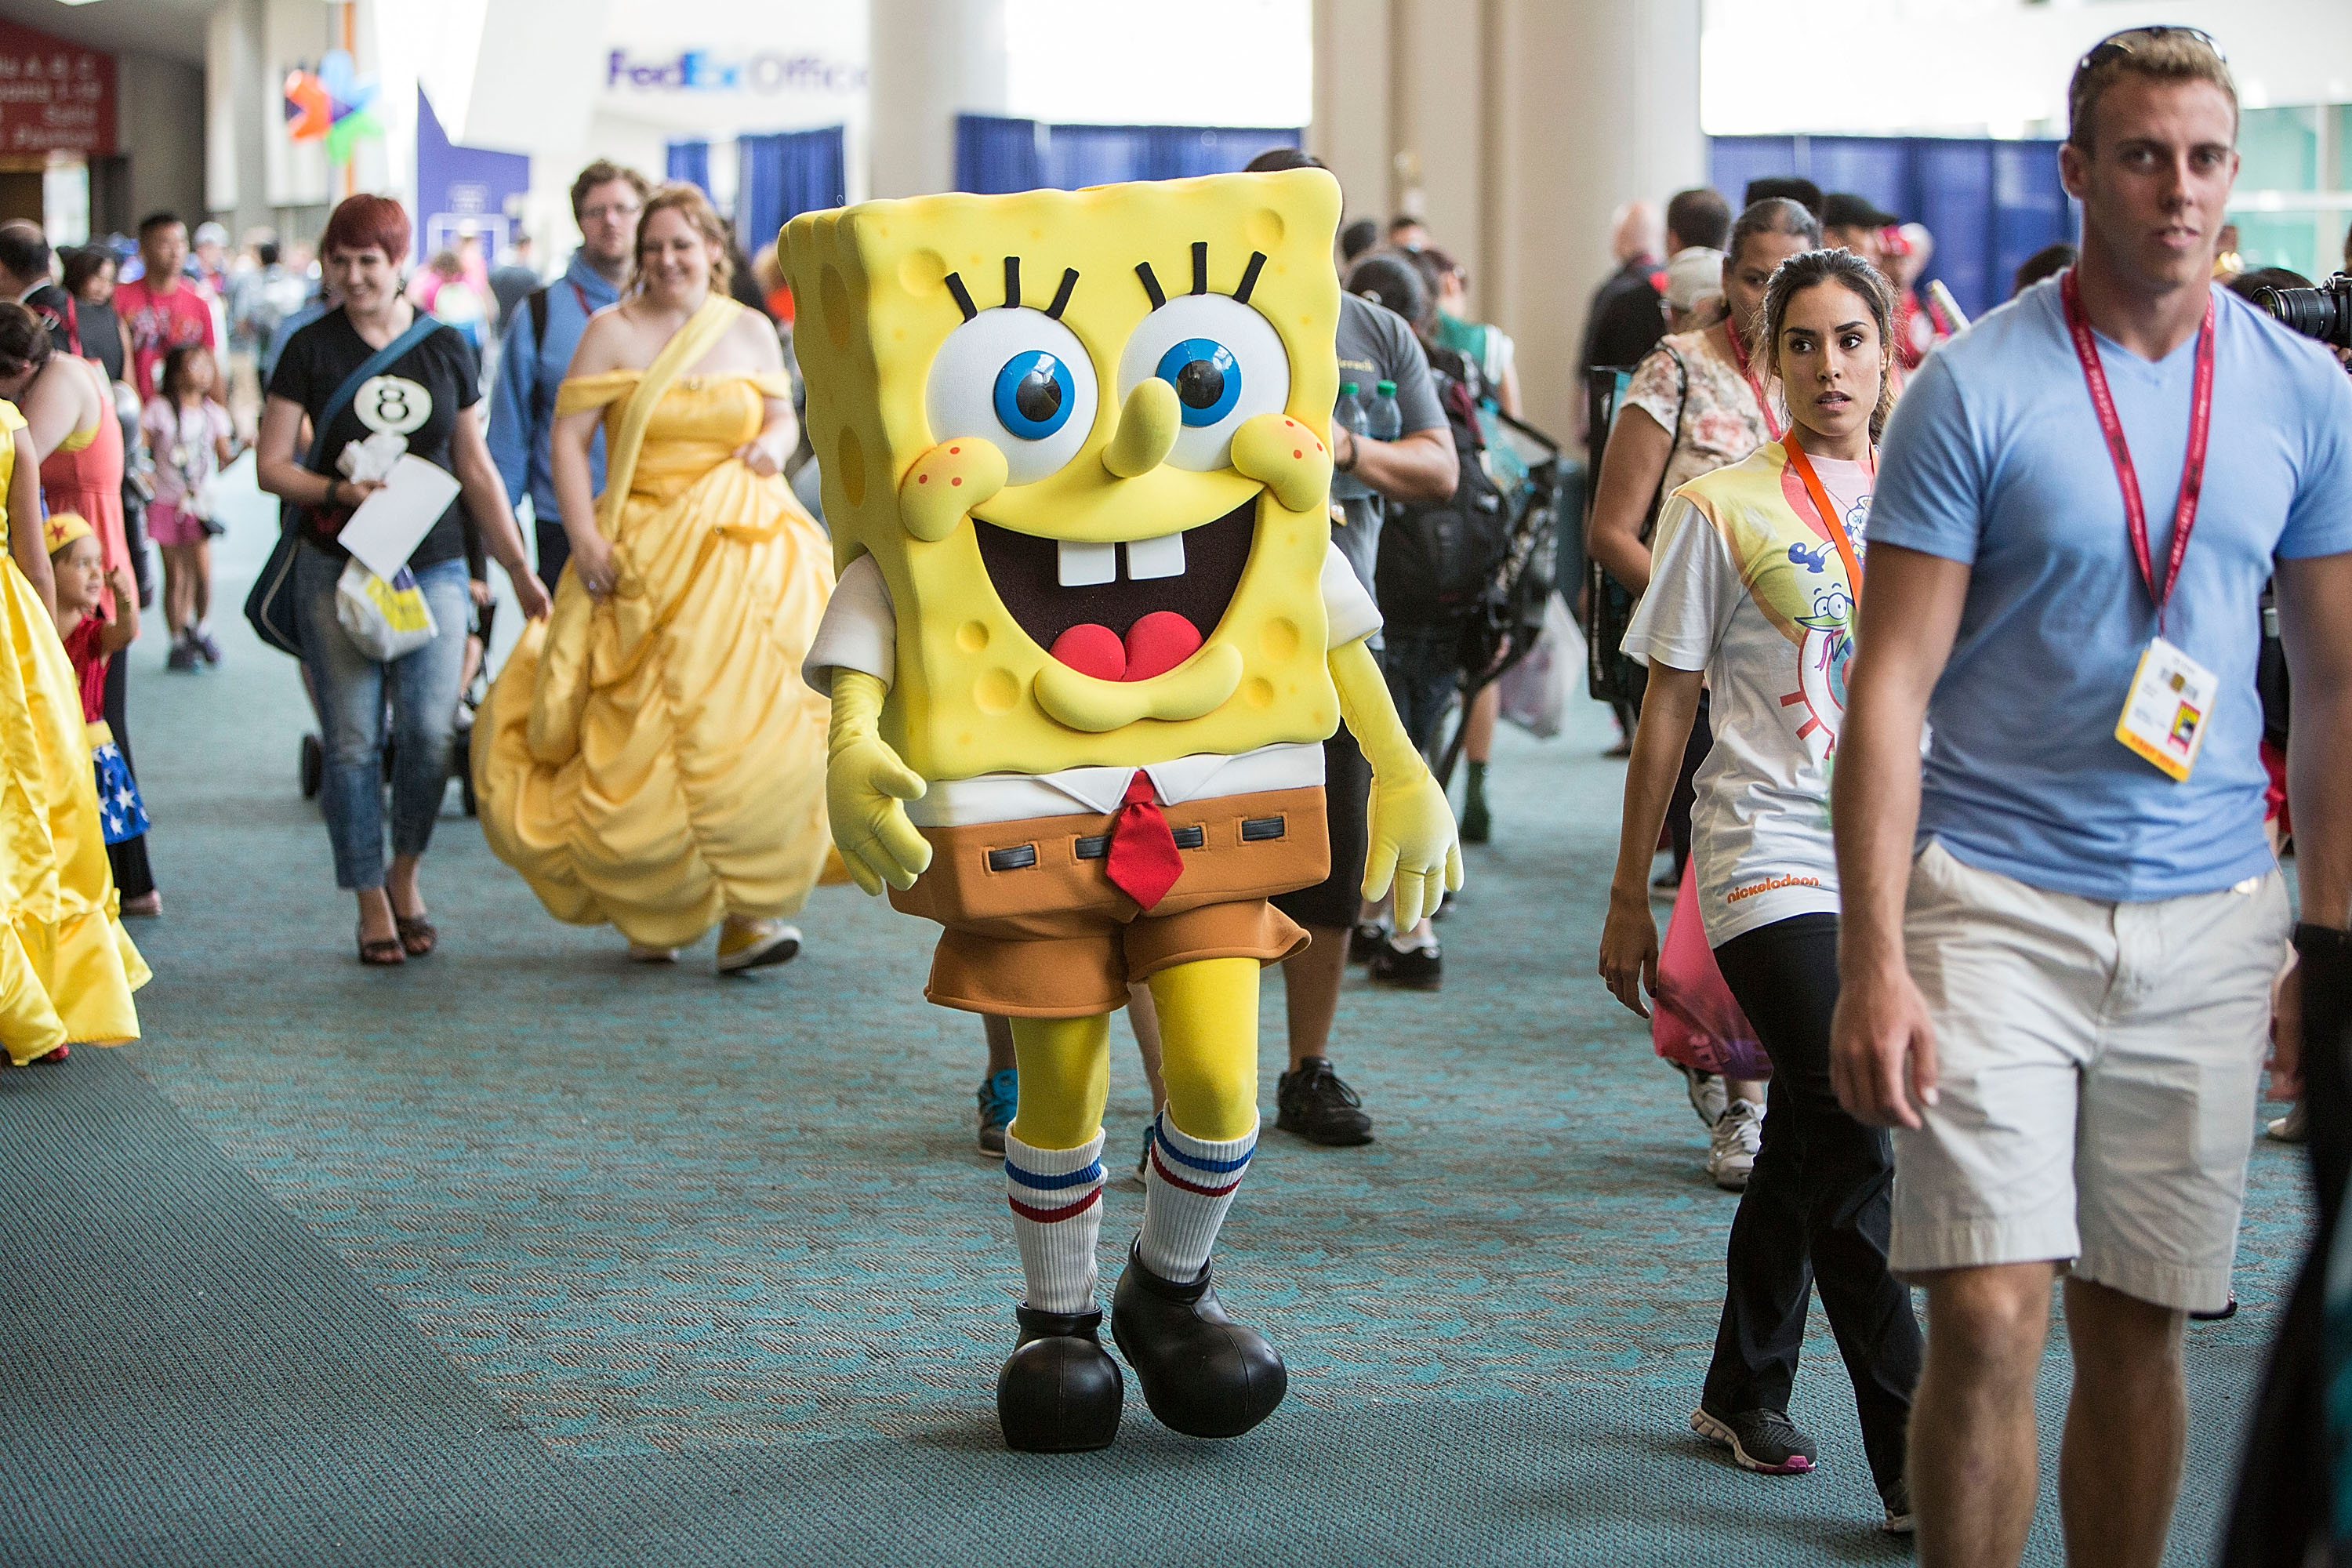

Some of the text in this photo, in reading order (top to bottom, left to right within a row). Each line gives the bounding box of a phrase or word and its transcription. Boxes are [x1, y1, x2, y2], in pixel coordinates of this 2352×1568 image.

[608, 47, 740, 89] FedEx
[377, 386, 408, 423] 8
[1727, 873, 1819, 903] nickelodeon
